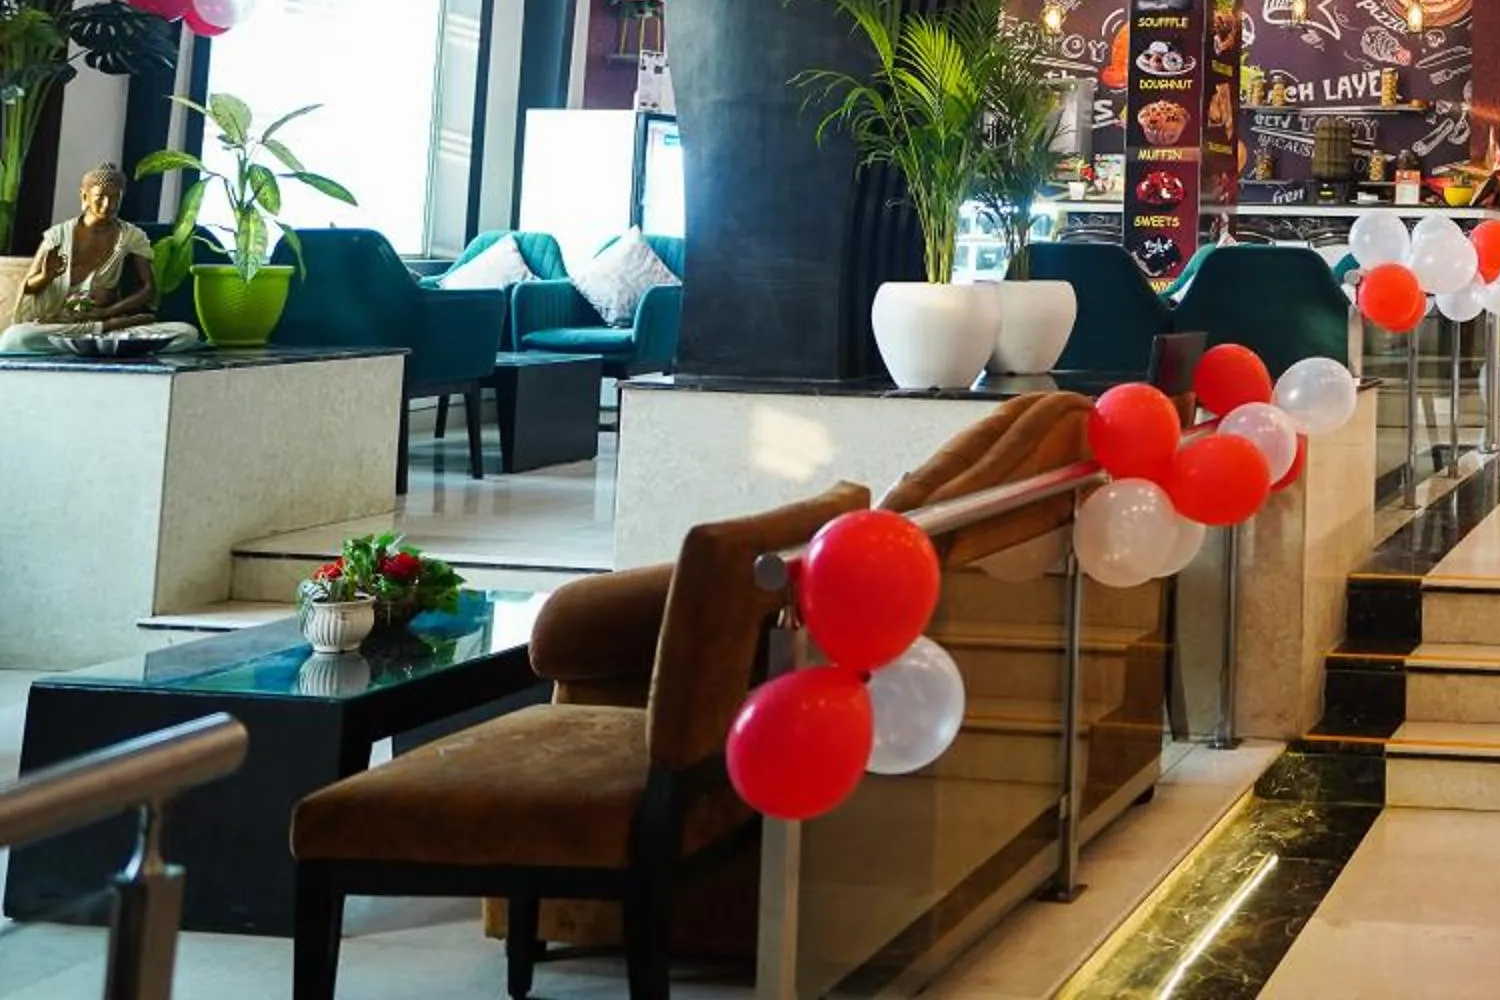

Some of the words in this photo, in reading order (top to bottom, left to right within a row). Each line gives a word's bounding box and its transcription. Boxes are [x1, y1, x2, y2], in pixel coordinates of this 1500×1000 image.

[1139, 78, 1193, 90] DOUGHNUT
[1137, 149, 1183, 161] MUFFIN
[1133, 215, 1181, 228] SWEETS
